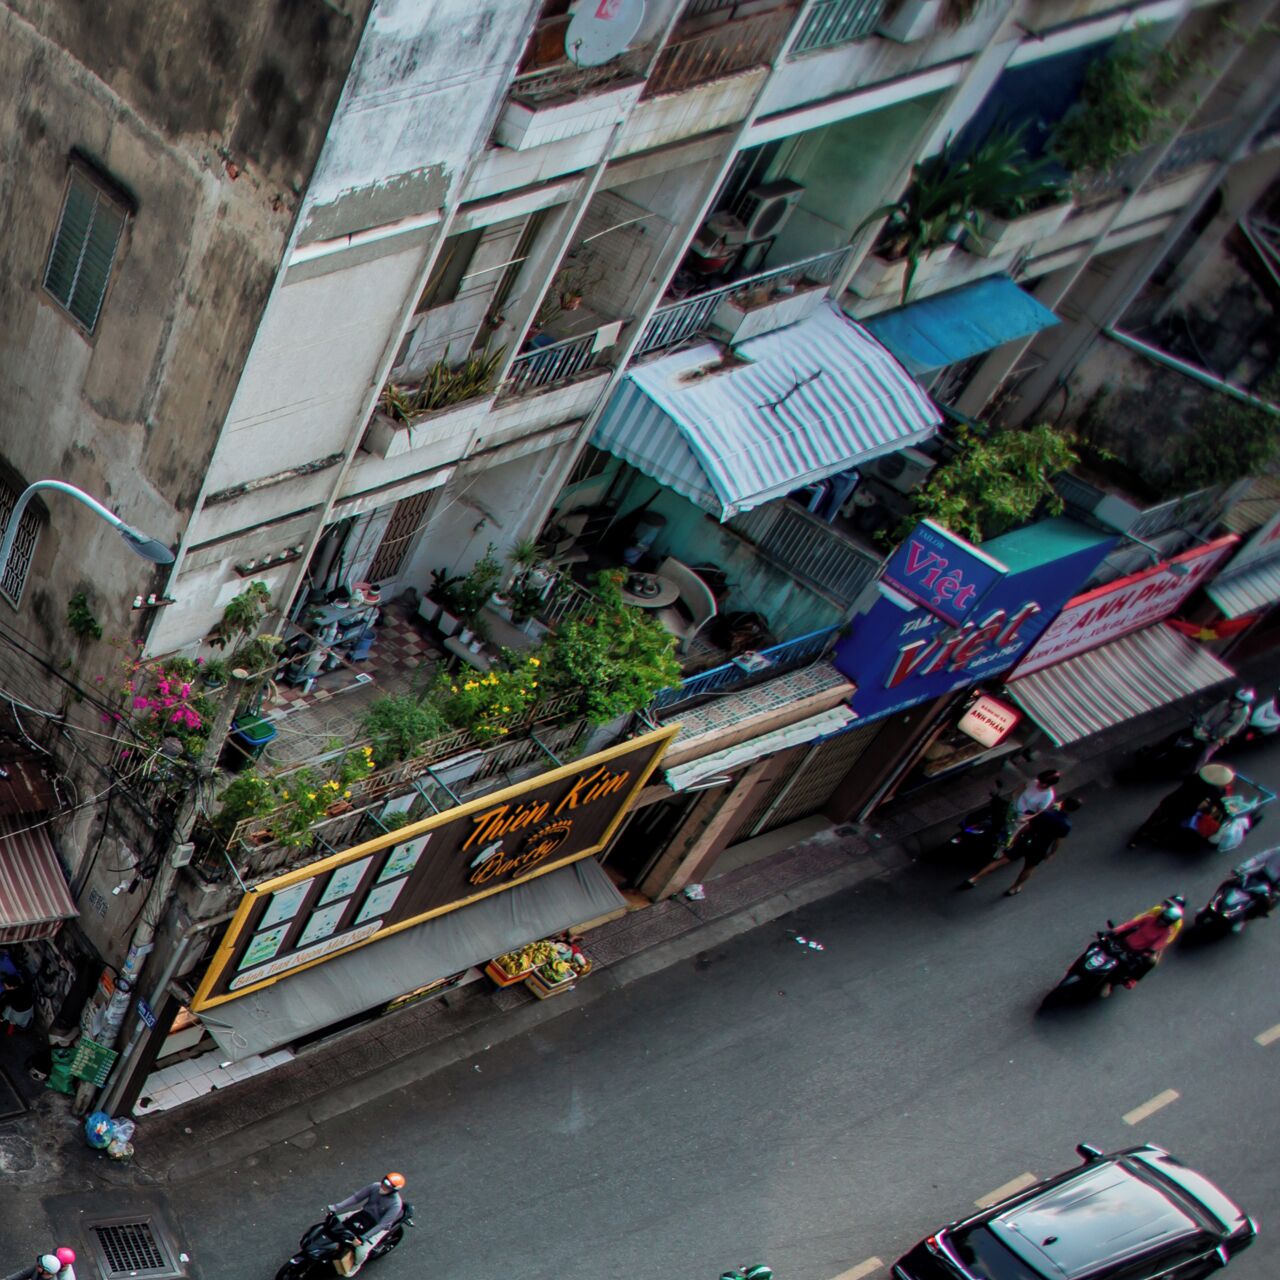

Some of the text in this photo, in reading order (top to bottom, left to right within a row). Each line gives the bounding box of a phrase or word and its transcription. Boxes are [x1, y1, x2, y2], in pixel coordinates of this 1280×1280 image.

[904, 540, 976, 609] Việt
[463, 765, 630, 851] Thiên Kim
